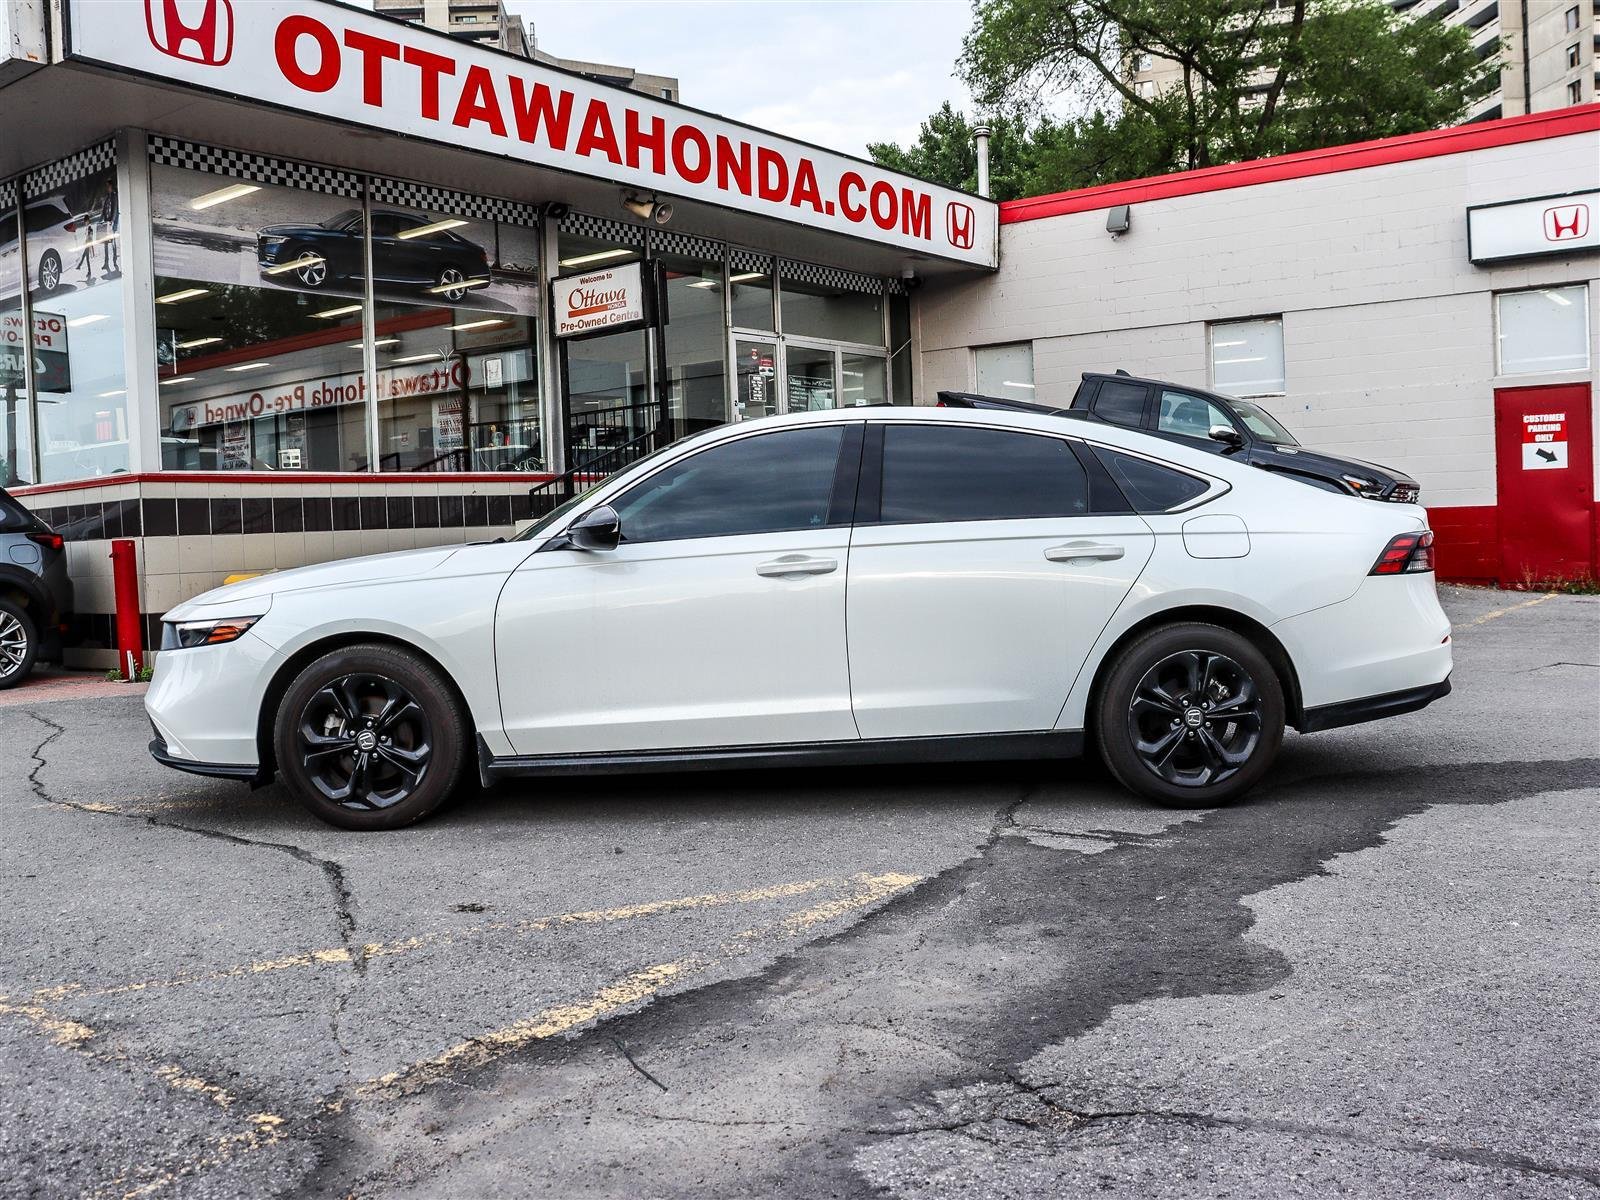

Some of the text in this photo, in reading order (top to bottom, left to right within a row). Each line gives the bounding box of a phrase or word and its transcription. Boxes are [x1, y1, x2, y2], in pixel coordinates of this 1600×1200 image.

[275, 15, 931, 241] OTTAWAHONDA.COM
[579, 275, 605, 285] Welcome
[568, 287, 626, 310] Ottawa
[608, 301, 626, 310] HONDA
[560, 315, 607, 332] Pre-Owned
[1522, 413, 1566, 423] CUSTOMER
[1527, 423, 1561, 433] PARKING
[1535, 433, 1554, 442] ONLY
